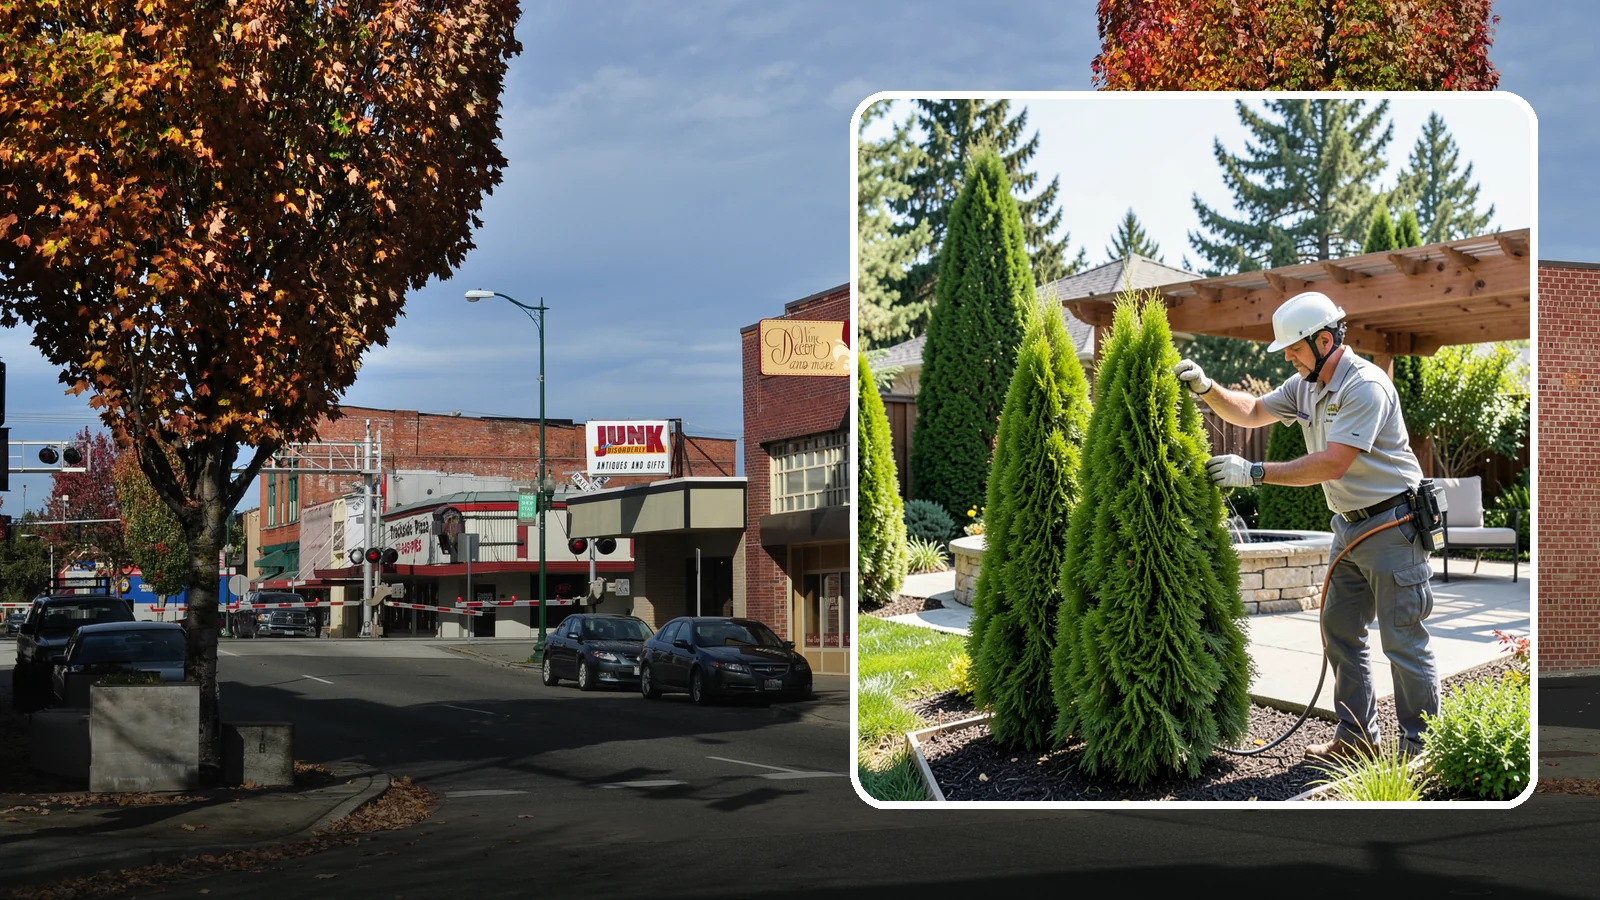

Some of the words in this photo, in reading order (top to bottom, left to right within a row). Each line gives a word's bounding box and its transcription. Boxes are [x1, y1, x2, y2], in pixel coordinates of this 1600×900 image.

[791, 325, 823, 345] Wine
[595, 425, 665, 457] JUNK
[607, 446, 645, 454] DISORDERLY
[597, 461, 628, 470] ANTIQUES
[631, 461, 643, 470] AND
[647, 460, 665, 469] GIFTS
[573, 473, 589, 493] RAIL
[590, 476, 608, 491] SING
[390, 521, 413, 539] Trackside
[415, 519, 429, 535] Pizza
